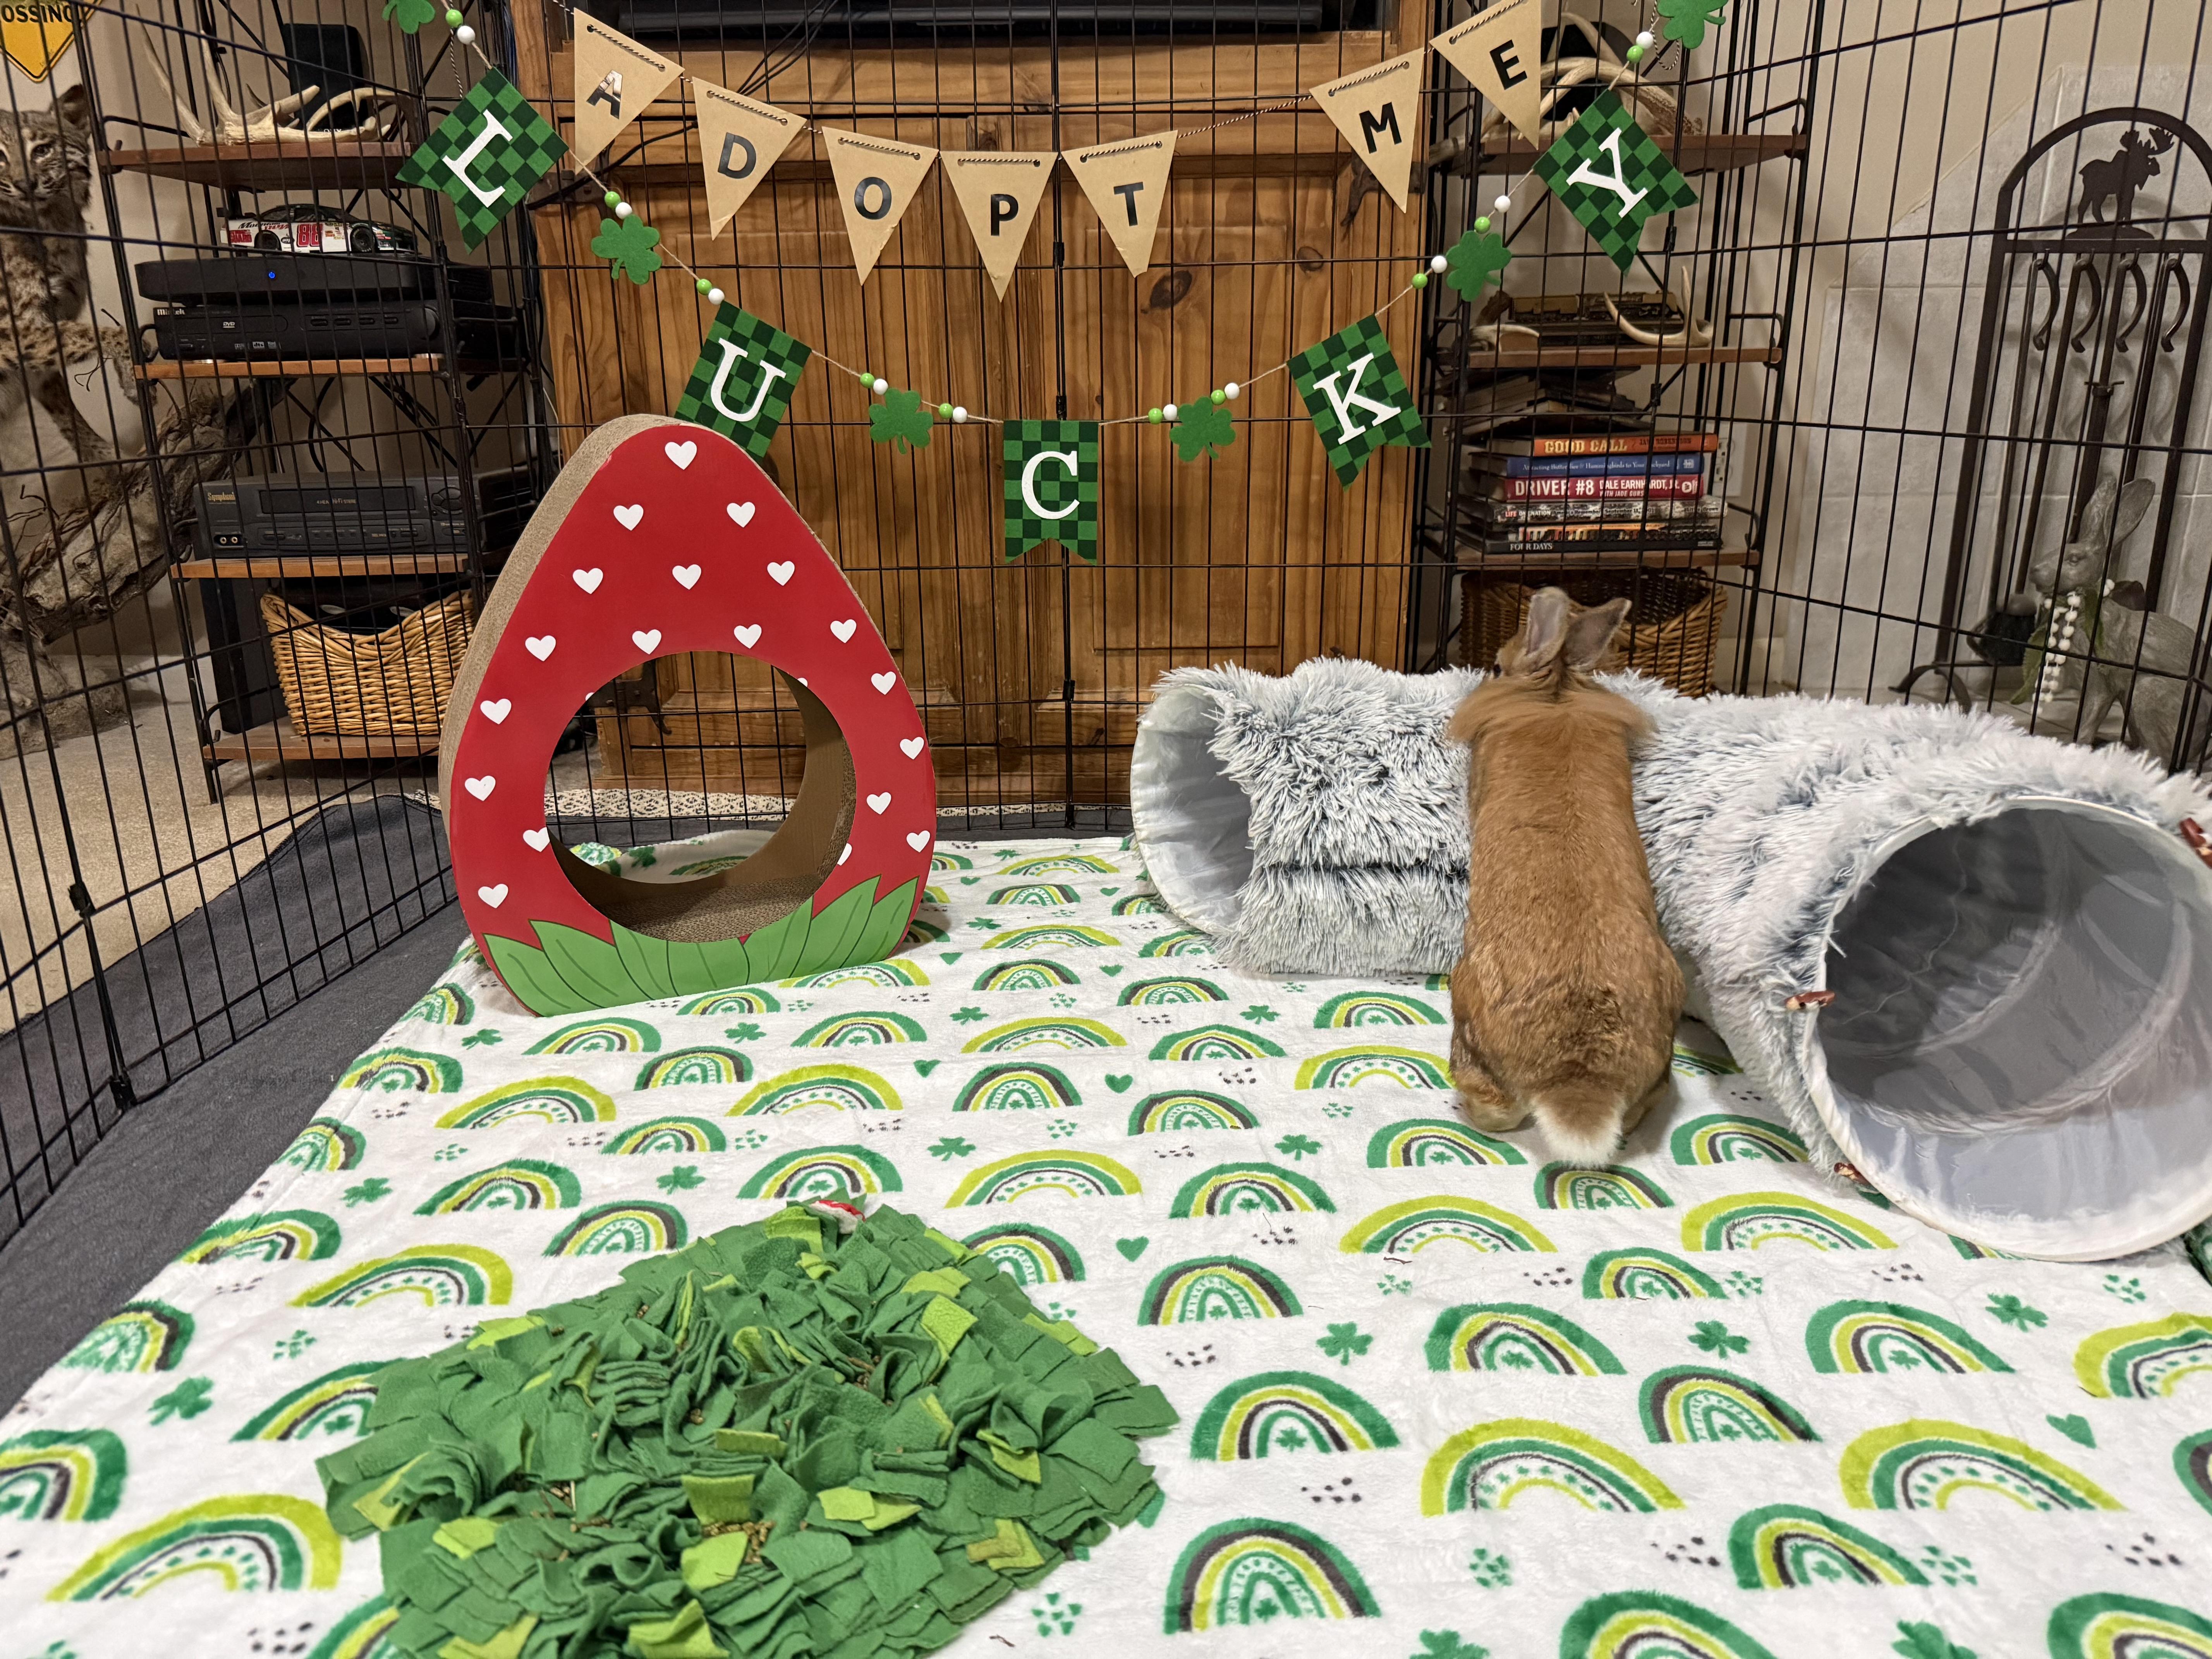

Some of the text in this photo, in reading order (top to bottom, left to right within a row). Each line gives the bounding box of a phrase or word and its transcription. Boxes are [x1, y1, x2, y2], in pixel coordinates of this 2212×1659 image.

[297, 223, 323, 247] 88
[1544, 438, 1627, 454] GOOD CALL
[1515, 479, 1594, 496] DRIVER #8
[1599, 480, 1619, 489] DALE
